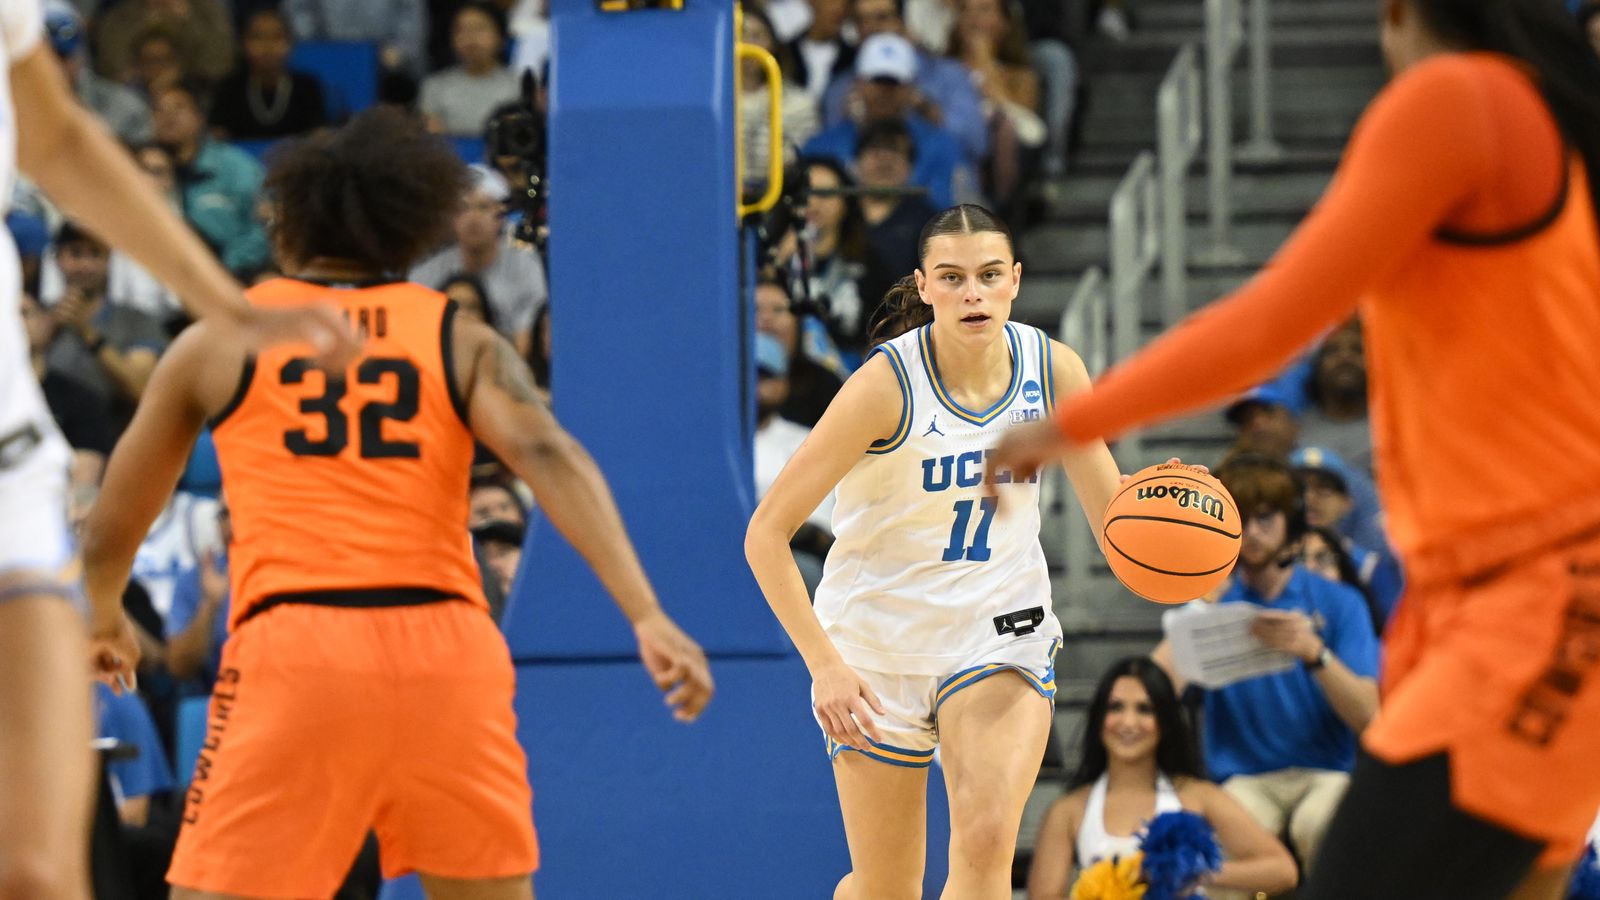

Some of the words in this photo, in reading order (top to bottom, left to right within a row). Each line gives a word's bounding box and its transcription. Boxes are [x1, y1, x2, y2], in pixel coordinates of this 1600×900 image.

[279, 356, 421, 459] 32
[922, 449, 1037, 492] UC
[941, 495, 999, 562] 11
[1136, 485, 1225, 522] Wilson
